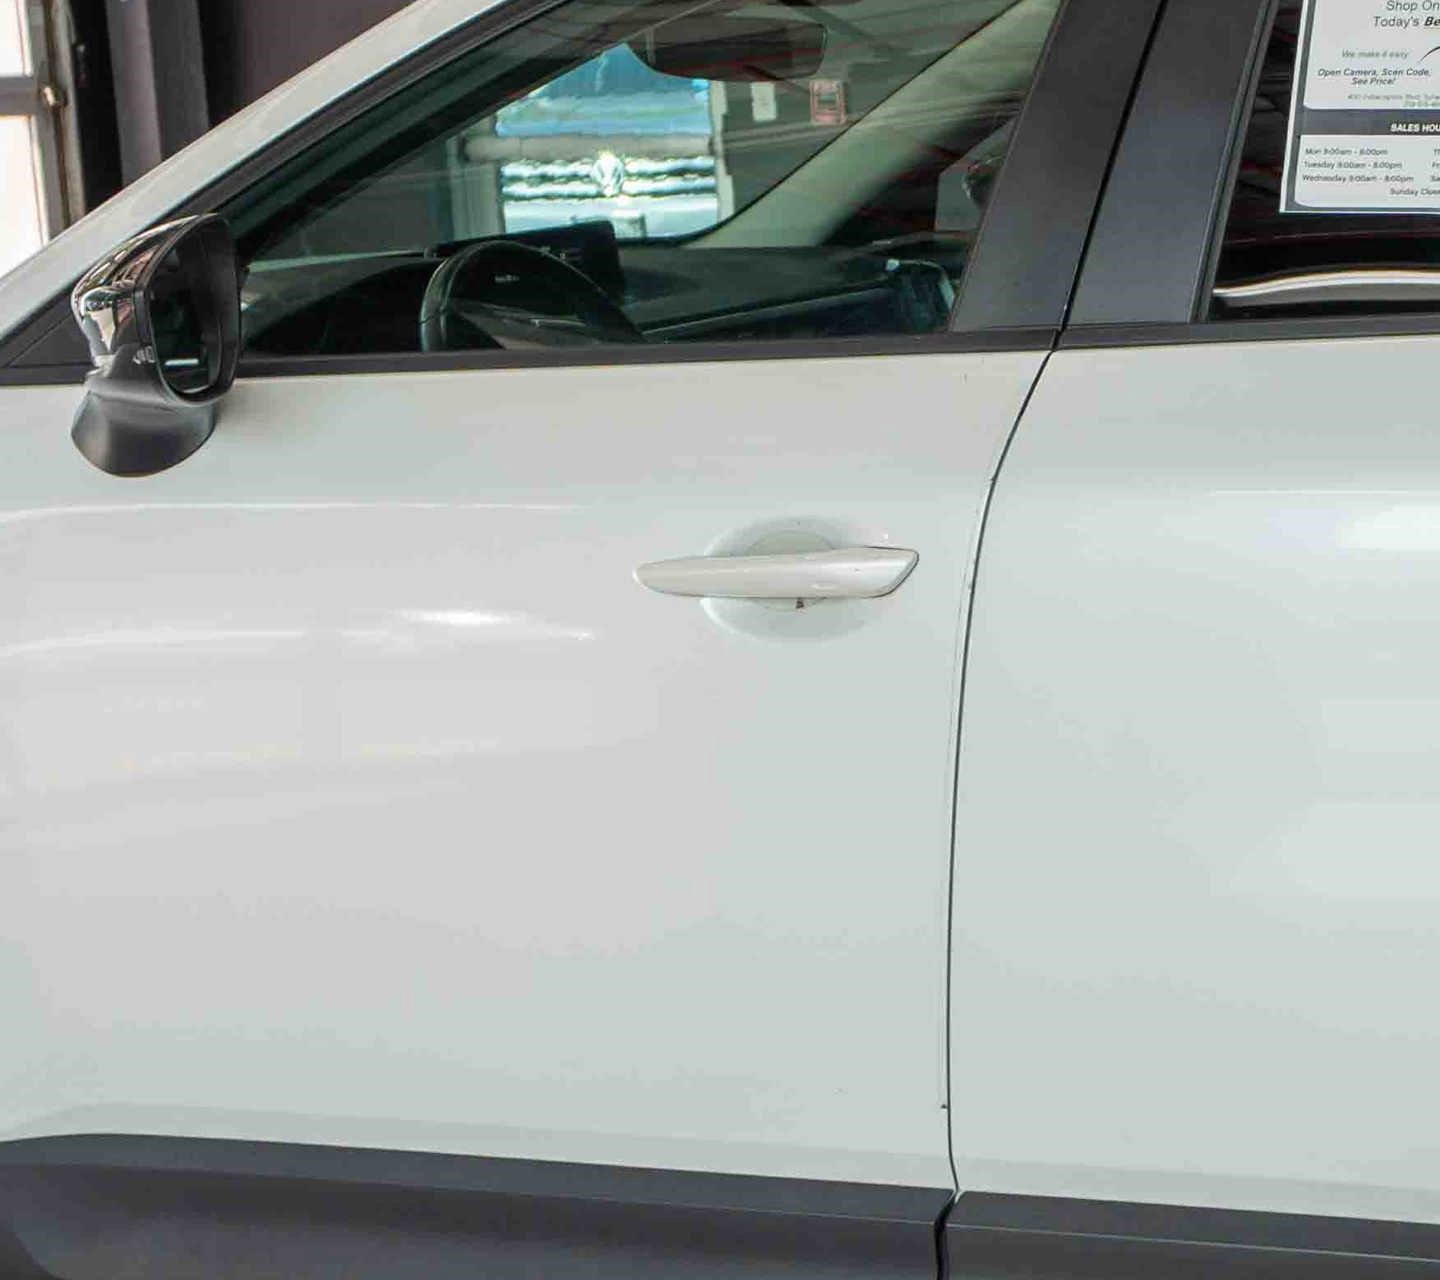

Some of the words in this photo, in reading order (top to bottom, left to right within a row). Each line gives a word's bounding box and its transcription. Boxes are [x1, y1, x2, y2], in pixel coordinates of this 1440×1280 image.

[1386, 0, 1418, 13] Shop
[1373, 16, 1420, 29] Today's
[1318, 68, 1341, 78] Open
[1351, 77, 1368, 86] See
[1390, 123, 1420, 132] SALES
